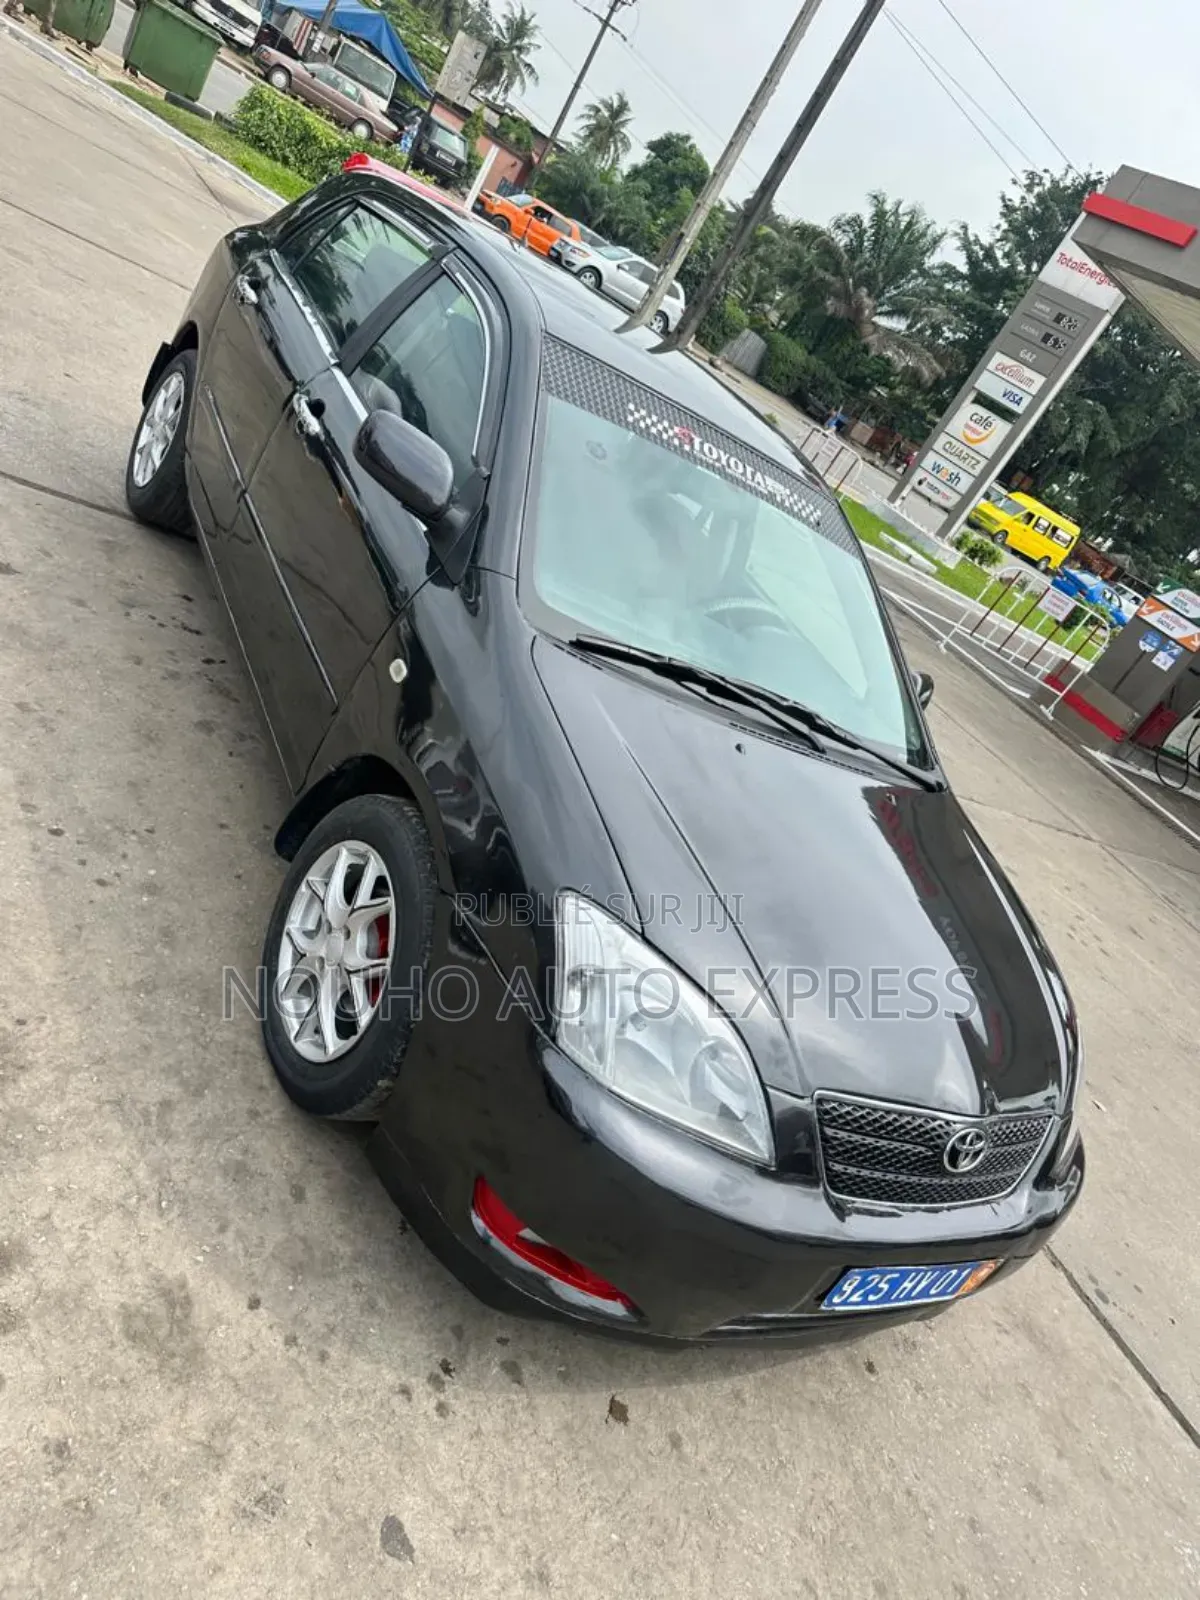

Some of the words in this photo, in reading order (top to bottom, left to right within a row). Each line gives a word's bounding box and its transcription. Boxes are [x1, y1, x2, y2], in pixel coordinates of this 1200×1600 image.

[1056, 252, 1117, 288] TotalEnergi
[995, 362, 1035, 388] excellium
[1002, 388, 1023, 406] VISA
[969, 412, 996, 431] café
[690, 434, 768, 490] TOYOTA
[942, 440, 981, 471] QUARTZ
[931, 460, 961, 487] wash
[832, 1274, 900, 1303] 925
